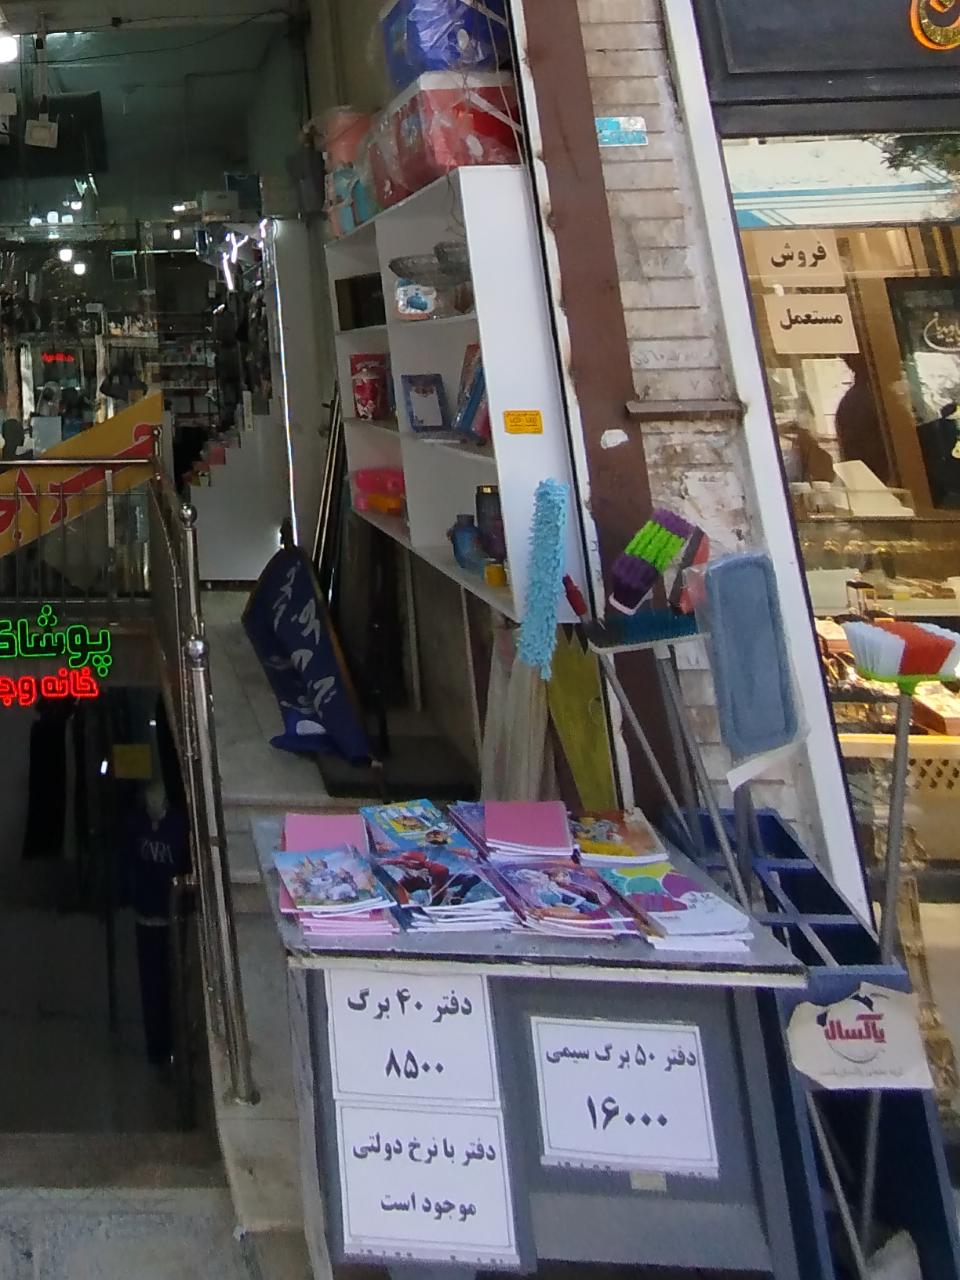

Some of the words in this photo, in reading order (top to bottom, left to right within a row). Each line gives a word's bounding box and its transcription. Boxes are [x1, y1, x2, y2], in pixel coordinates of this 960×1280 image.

[771, 239, 828, 269] فروش
[780, 309, 844, 331] مستعمل
[41, 667, 101, 699] خانه
[347, 989, 391, 1020] برگ
[397, 988, 424, 1014] ۴۰
[433, 990, 473, 1023] دفتر
[385, 1048, 445, 1079] ۸۵۰۰
[546, 1044, 589, 1066] سیمی
[594, 1043, 630, 1069] برگ
[635, 1044, 656, 1064] ۵۰
[664, 1046, 697, 1072] دفتر
[586, 1096, 668, 1131] ۱۶۰۰۰
[352, 1132, 403, 1162] دولتی
[408, 1135, 439, 1165] نرخ
[443, 1137, 456, 1162] با
[462, 1138, 496, 1167] دفتر
[380, 1191, 417, 1213] است
[422, 1192, 477, 1222] موجود
